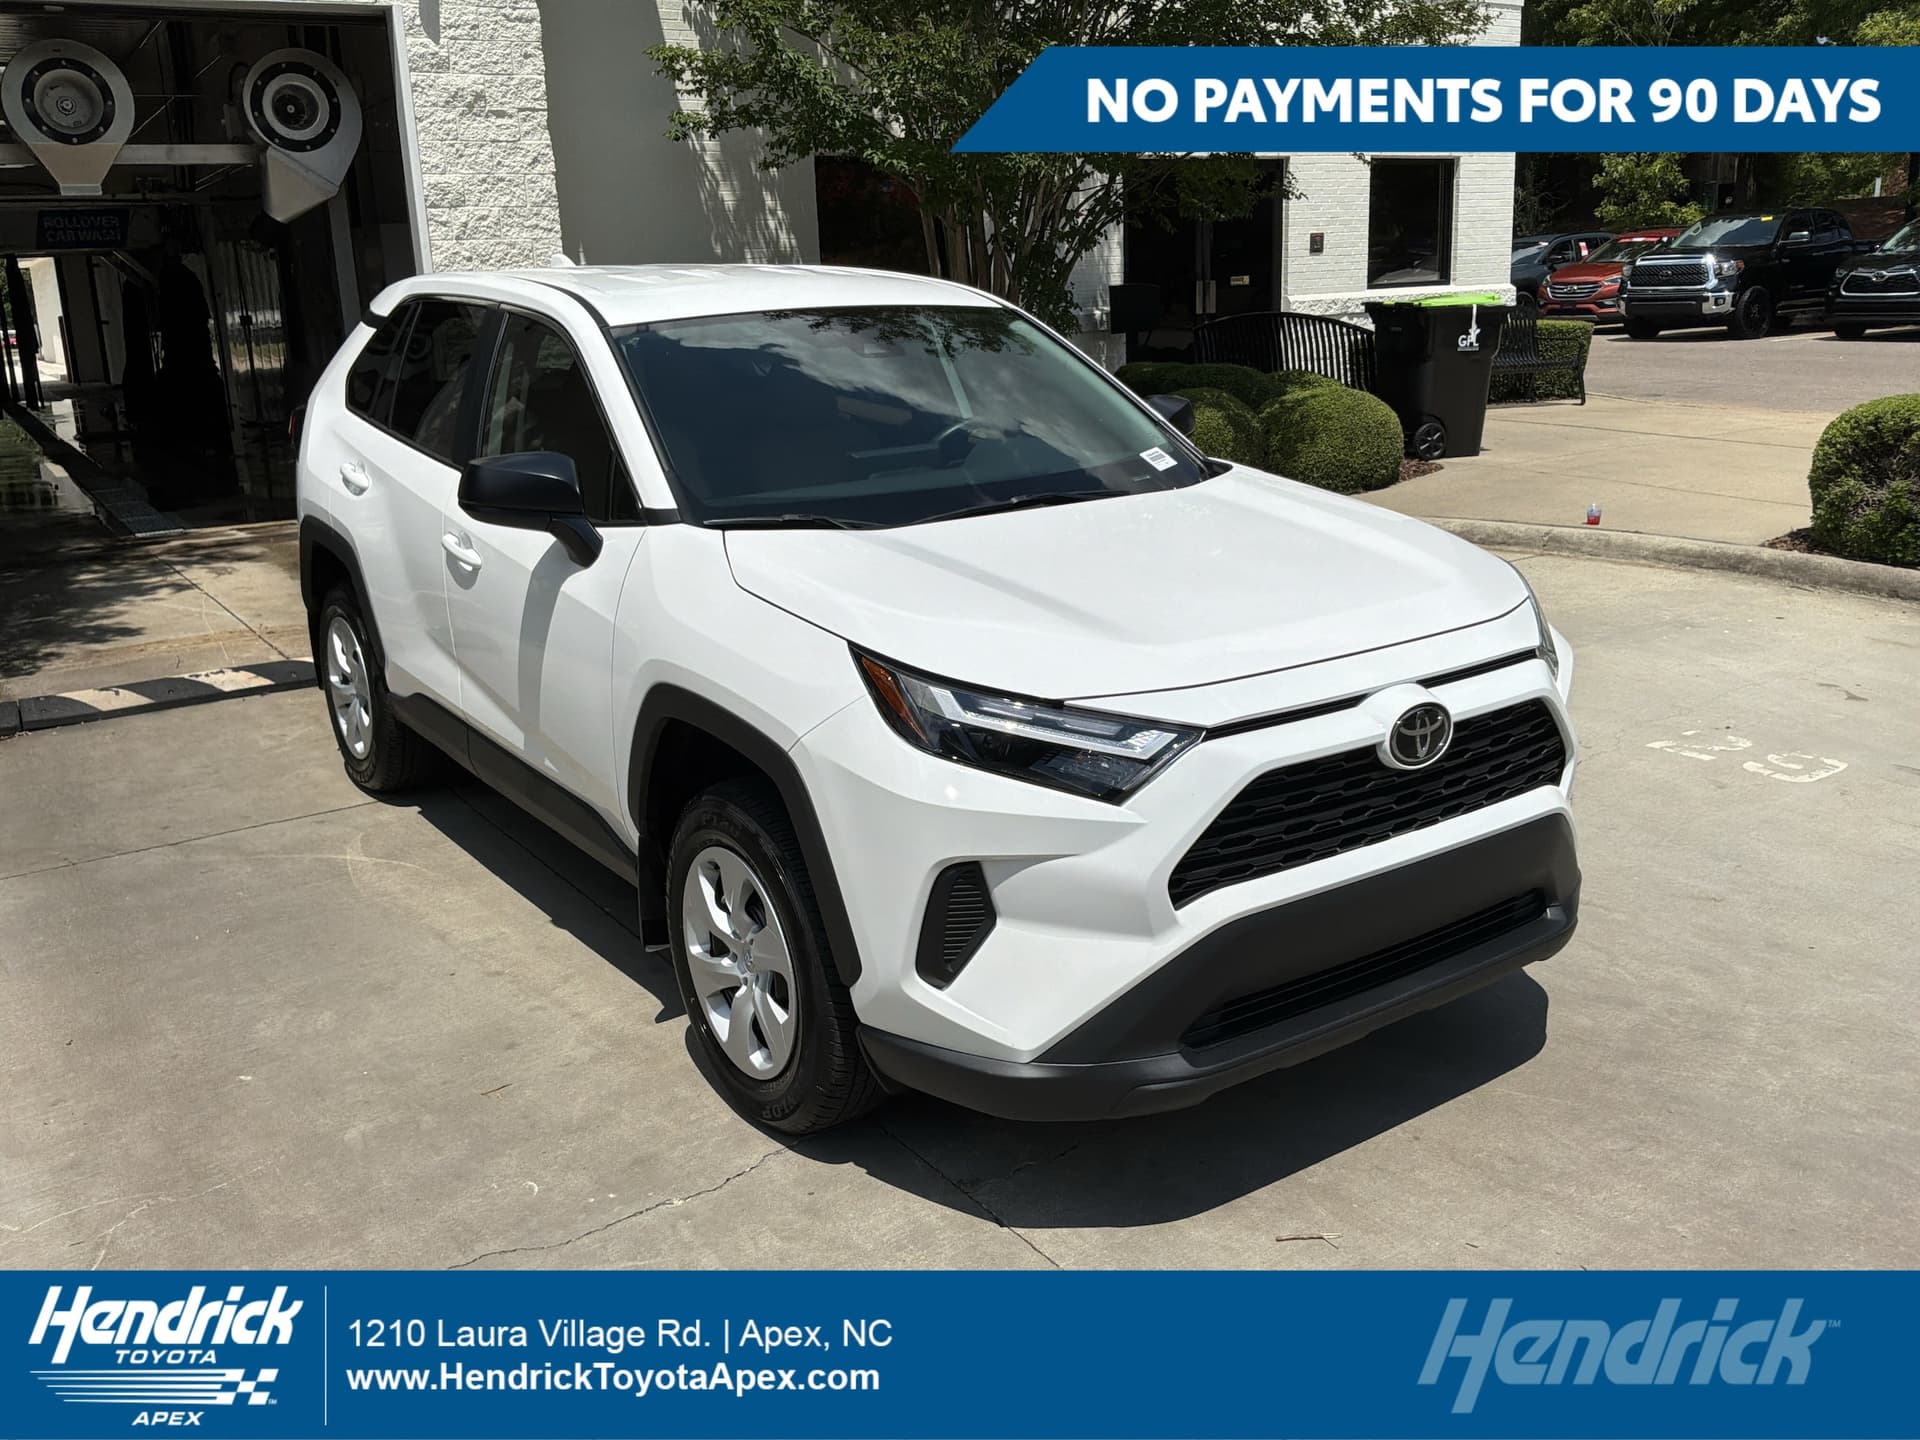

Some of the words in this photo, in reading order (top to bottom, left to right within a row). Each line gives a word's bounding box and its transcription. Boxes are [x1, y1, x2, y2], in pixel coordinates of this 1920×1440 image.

[43, 216, 121, 229] ROLLOVER
[46, 230, 76, 241] CAR
[78, 230, 122, 241] WASH
